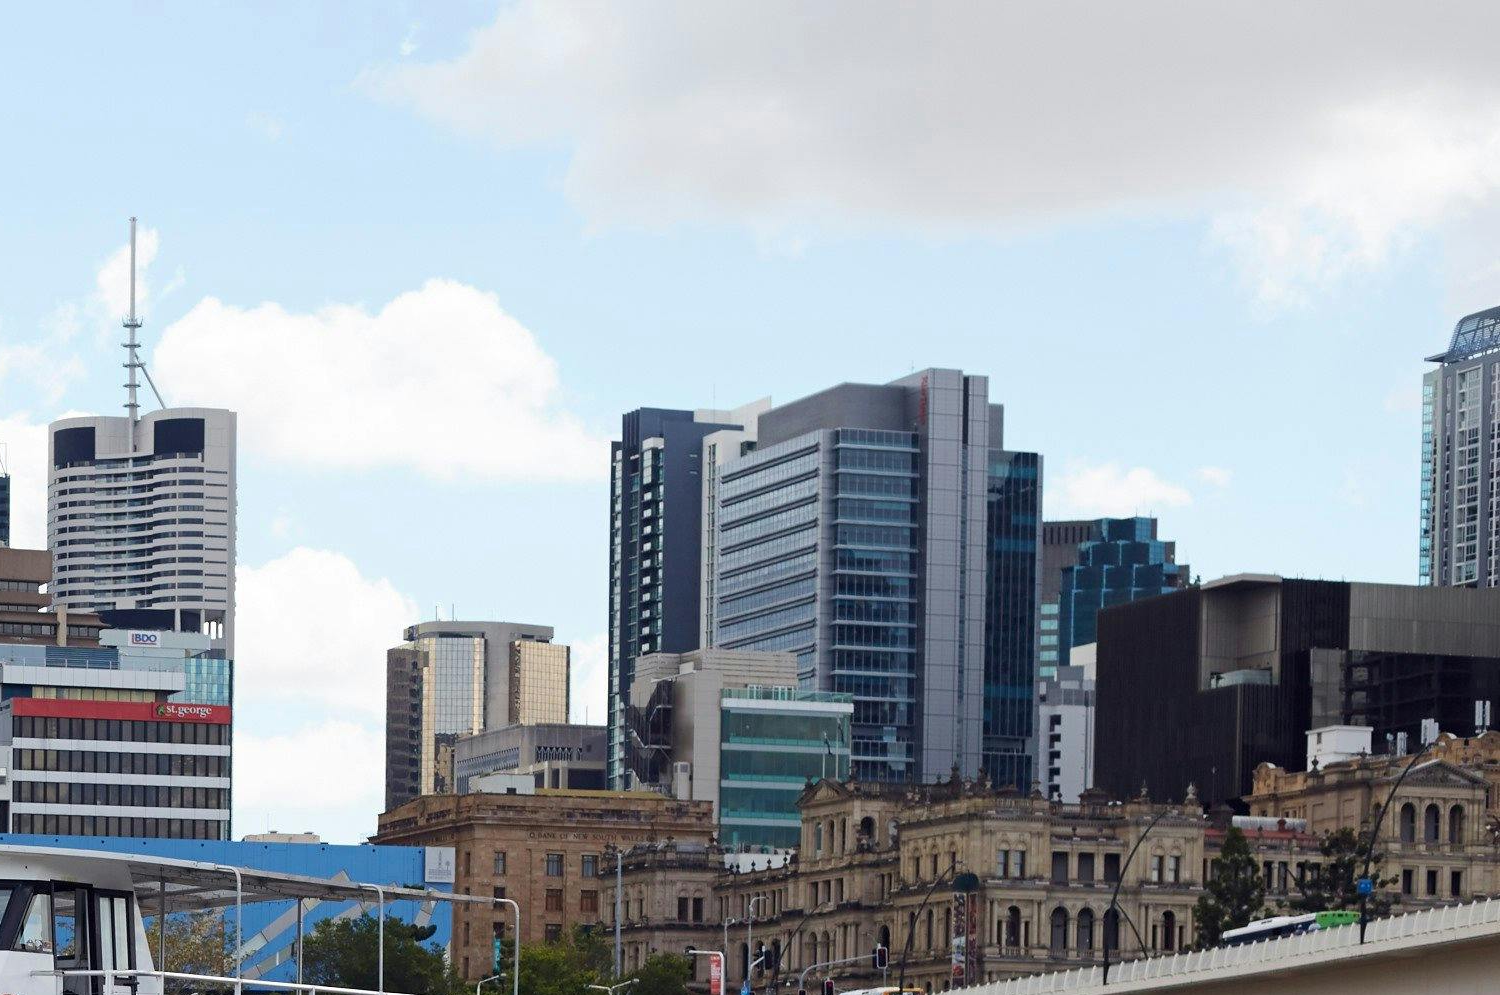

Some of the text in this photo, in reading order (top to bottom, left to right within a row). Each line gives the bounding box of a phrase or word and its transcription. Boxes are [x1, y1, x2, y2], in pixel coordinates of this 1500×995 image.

[134, 633, 157, 642] BDO
[166, 705, 212, 717] st.george
[573, 832, 588, 840] NEW
[592, 833, 617, 841] SOUTH
